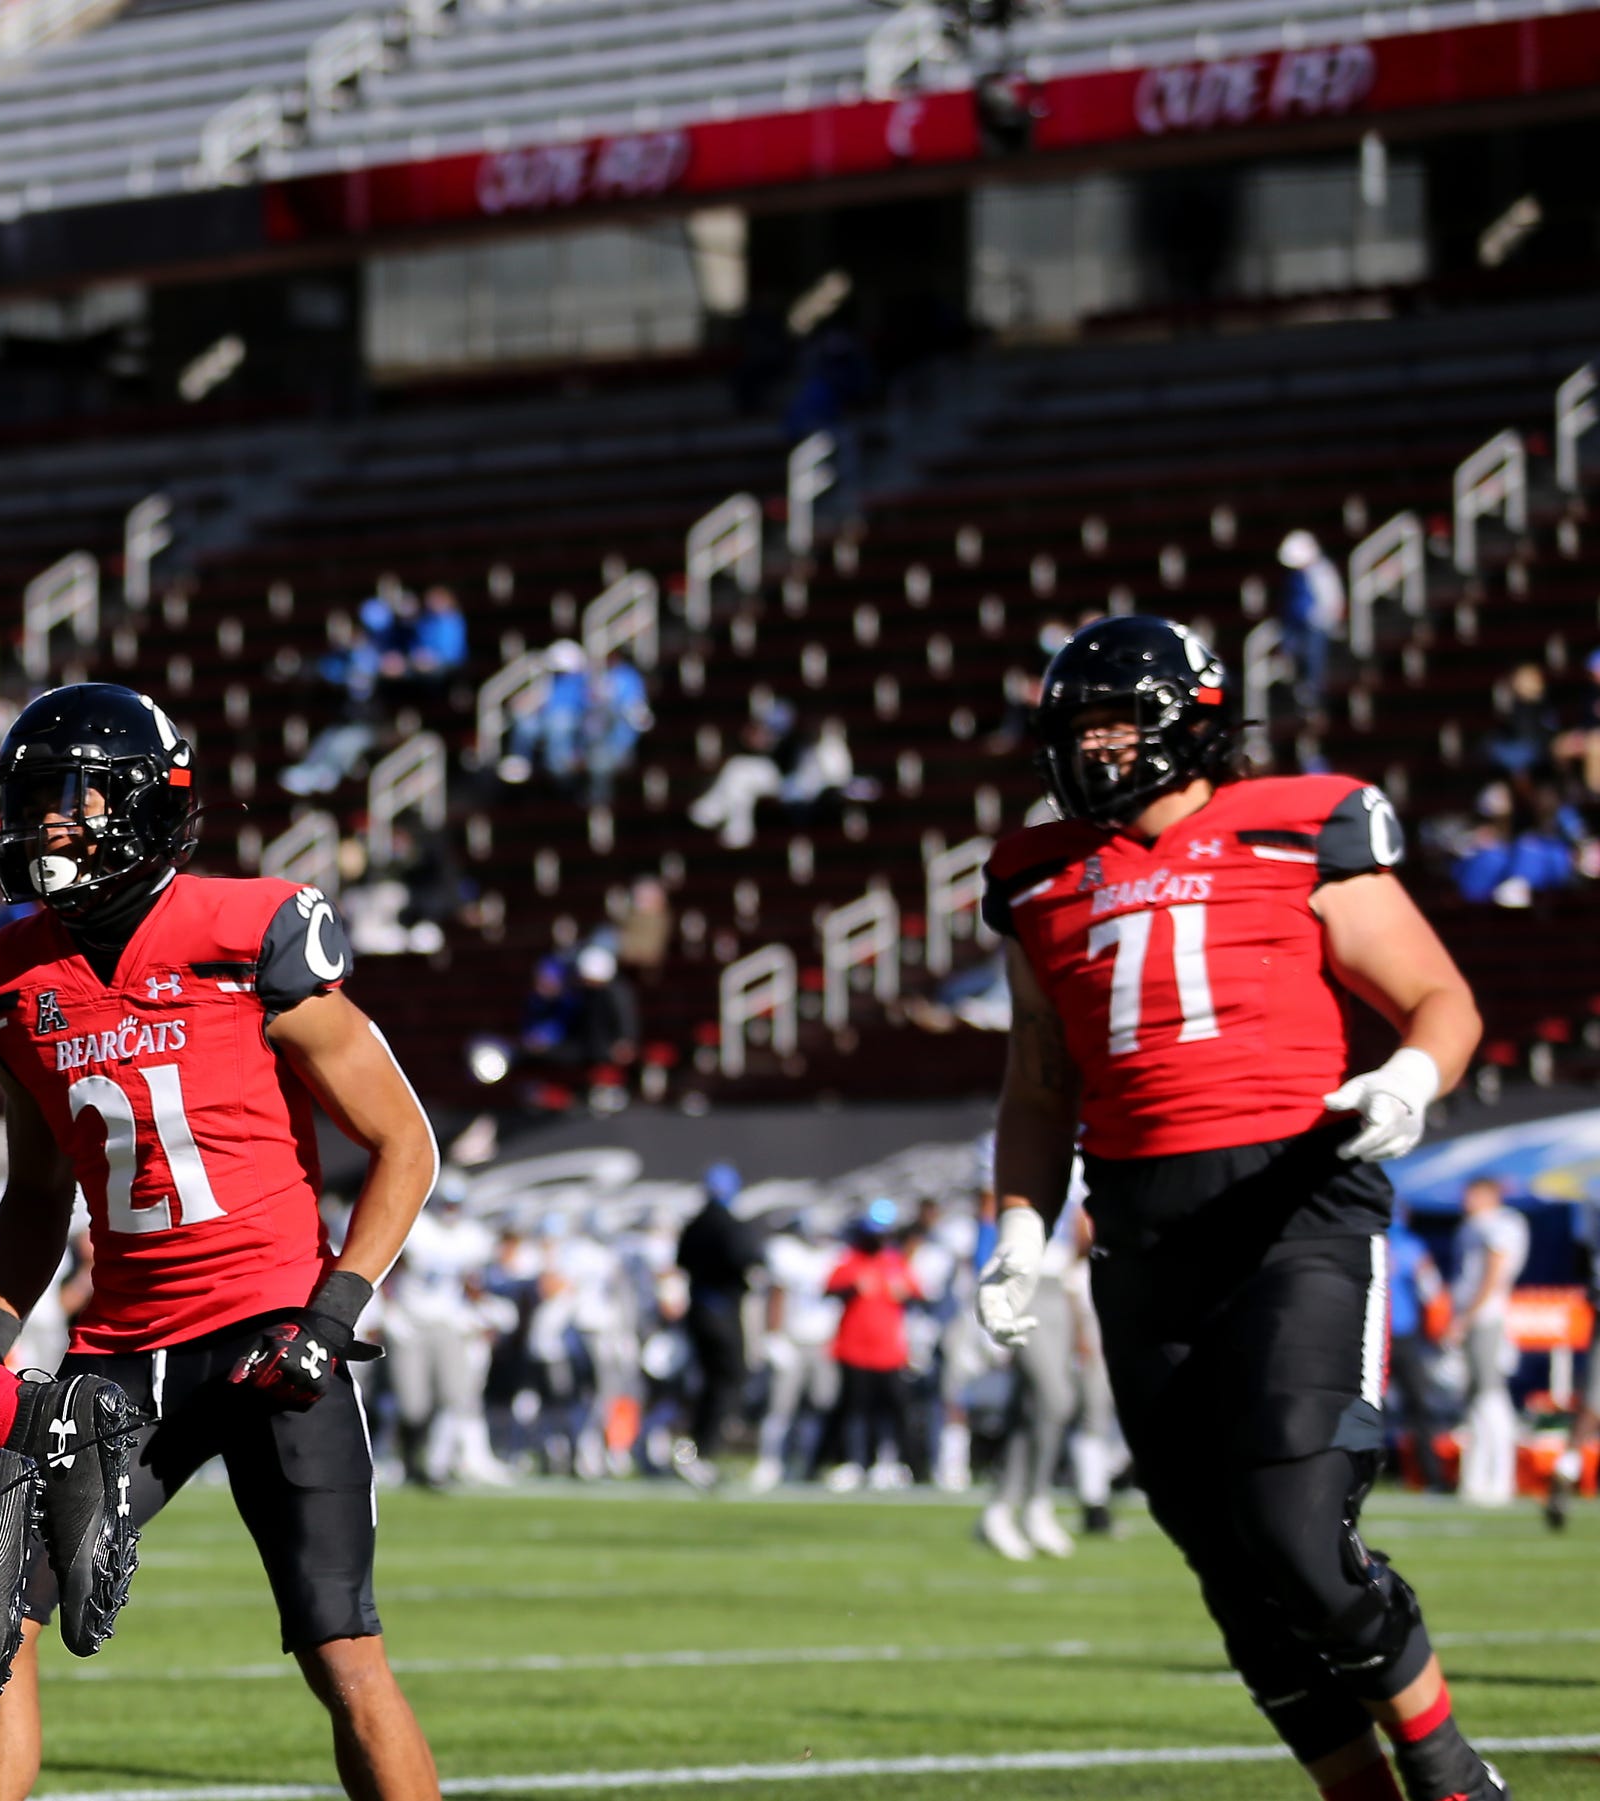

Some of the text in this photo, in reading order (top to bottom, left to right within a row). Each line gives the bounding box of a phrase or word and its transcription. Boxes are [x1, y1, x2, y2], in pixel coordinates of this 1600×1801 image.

[1090, 868, 1216, 917] BEARCATS
[1087, 902, 1221, 1056] 71
[56, 1015, 187, 1072] BEARCATS
[68, 1063, 229, 1234] 21
